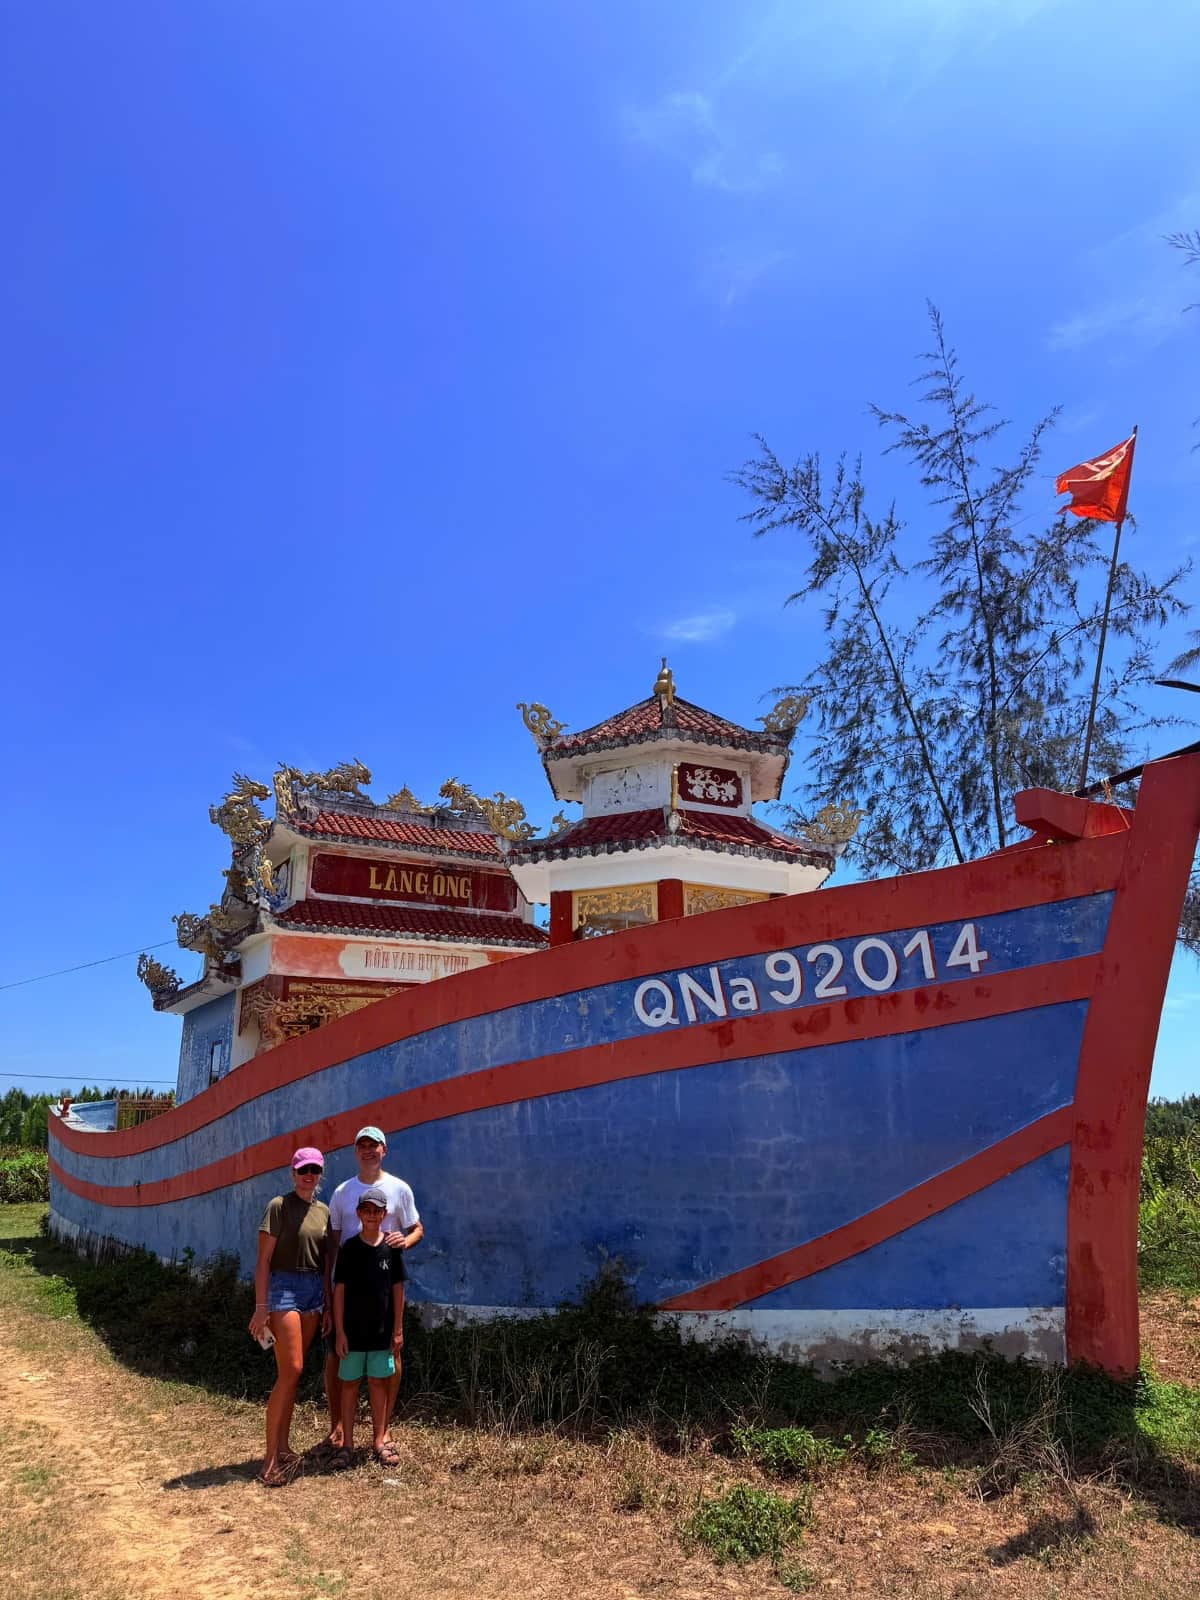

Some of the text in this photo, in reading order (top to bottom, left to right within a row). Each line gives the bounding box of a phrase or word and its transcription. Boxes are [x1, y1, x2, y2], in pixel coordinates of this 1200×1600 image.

[432, 869, 472, 898] ÔNG
[633, 923, 989, 1028] QNa 92014
